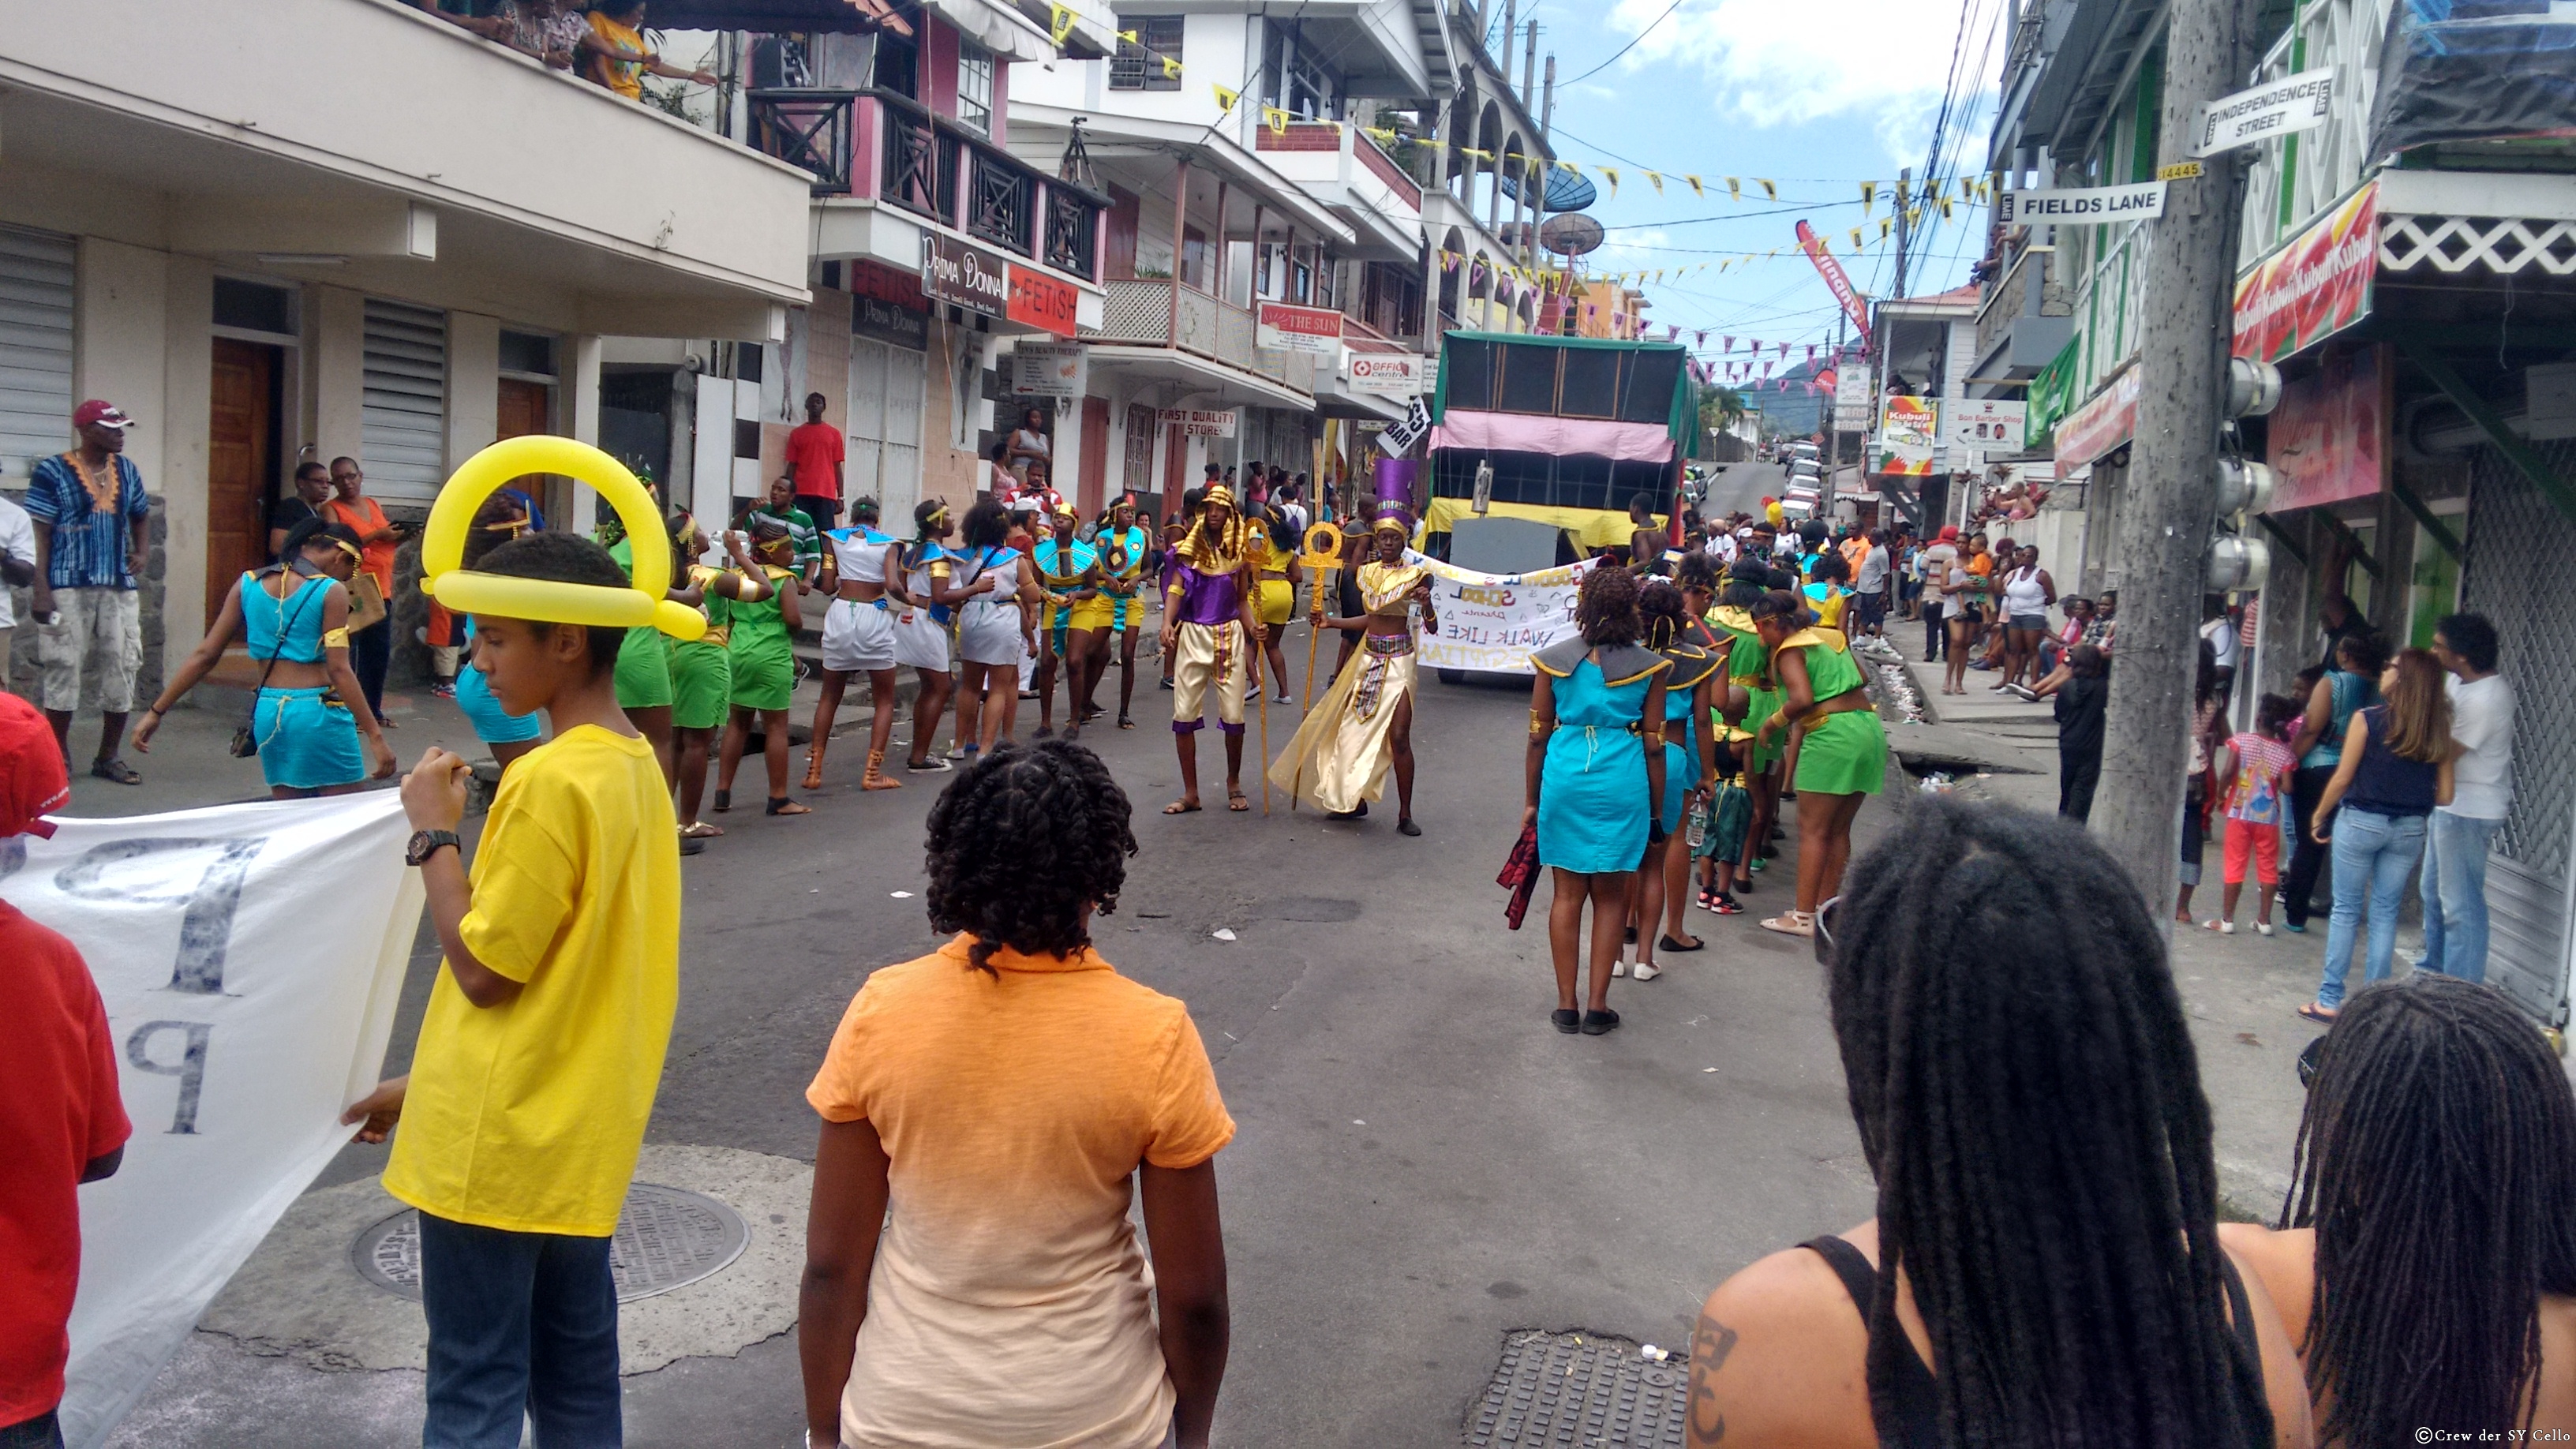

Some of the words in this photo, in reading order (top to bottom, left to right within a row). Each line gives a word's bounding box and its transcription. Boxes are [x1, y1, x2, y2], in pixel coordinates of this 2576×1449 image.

[2217, 81, 2317, 123] INDEPENDENCE
[2318, 80, 2331, 114] LIME
[2235, 111, 2286, 137] STREET
[2001, 195, 2012, 222] LIME
[2025, 198, 2102, 214] FIELDS
[2109, 193, 2157, 212] LANE
[922, 236, 959, 284] PRIMA
[964, 252, 1002, 298] DONNA
[1024, 277, 1078, 322] FETISH
[1289, 315, 1312, 329] THE
[1313, 317, 1338, 331] SUN
[1889, 411, 1930, 421] Kubuli
[2003, 415, 2023, 424] Shop
[1187, 425, 1219, 436] STORE
[1384, 421, 1412, 449] BAR
